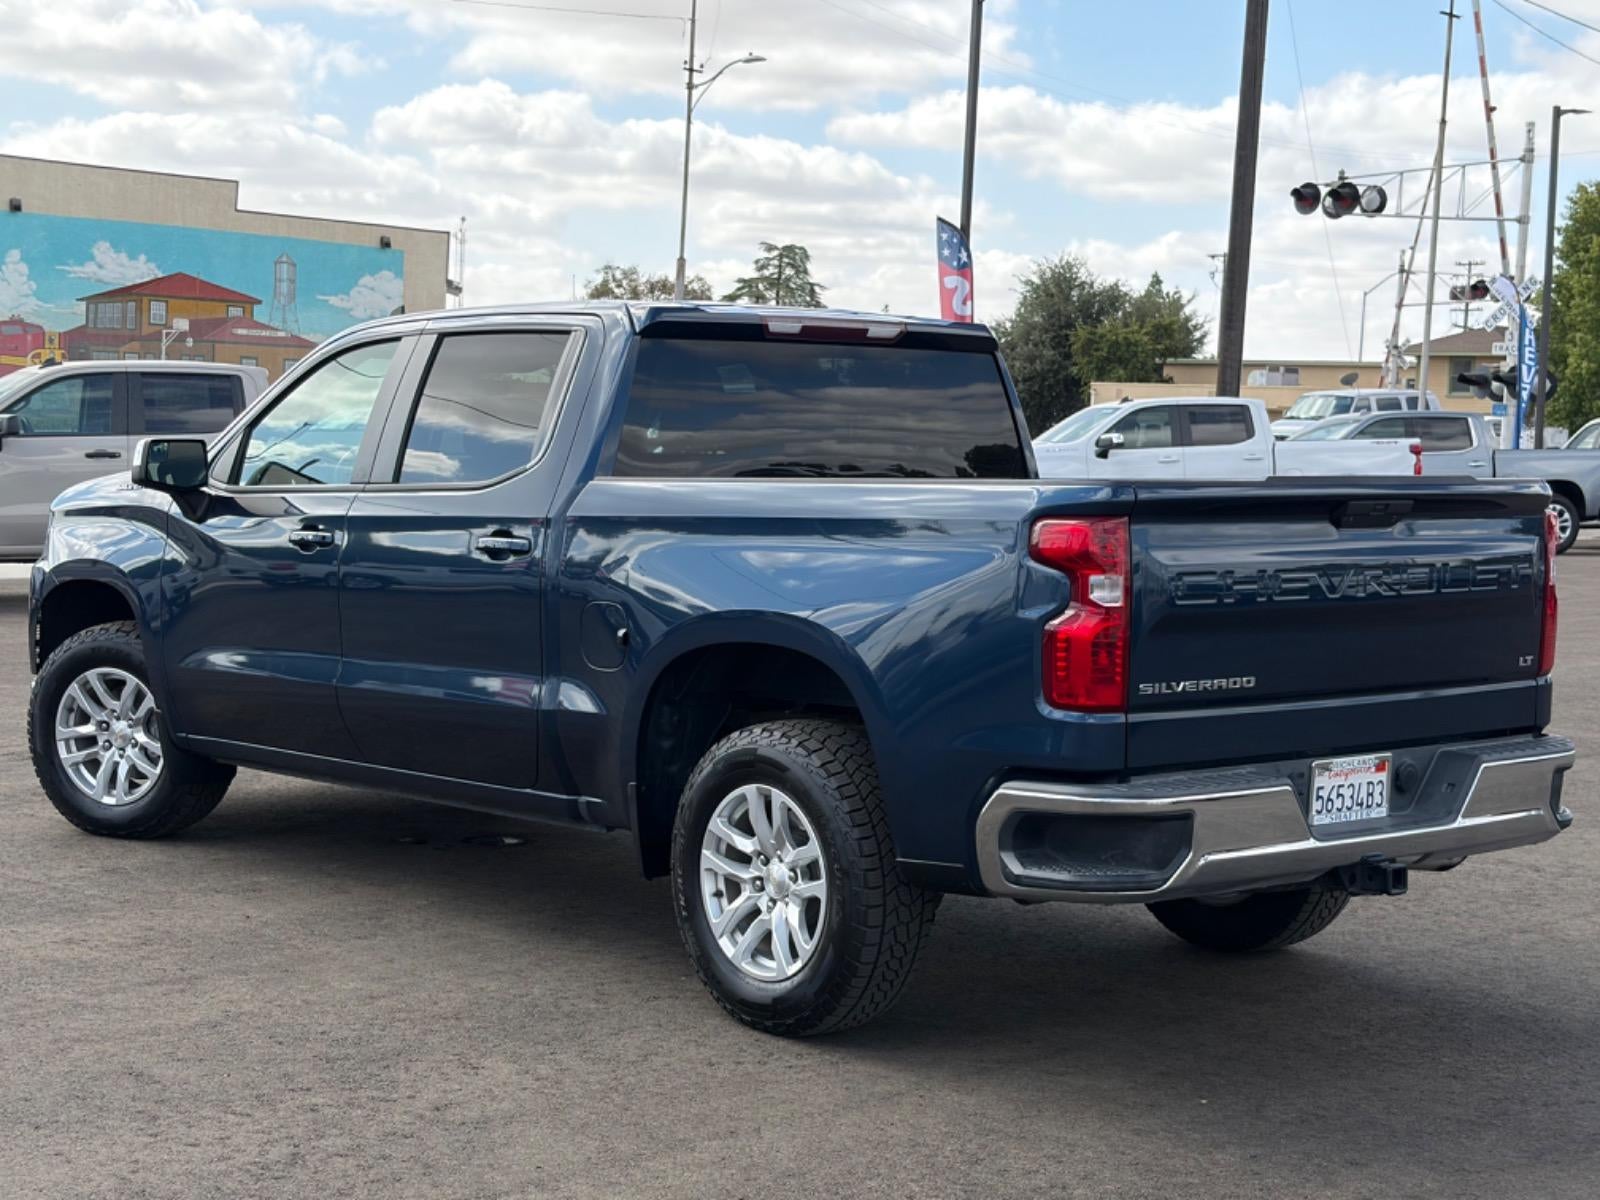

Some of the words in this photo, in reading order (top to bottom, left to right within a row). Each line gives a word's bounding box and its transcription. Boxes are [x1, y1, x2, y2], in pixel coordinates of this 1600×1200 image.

[1168, 562, 1531, 605] CHEVROLET
[1519, 655, 1533, 666] LT
[1138, 675, 1257, 695] SILVERADO
[1315, 780, 1385, 815] 56534B3
